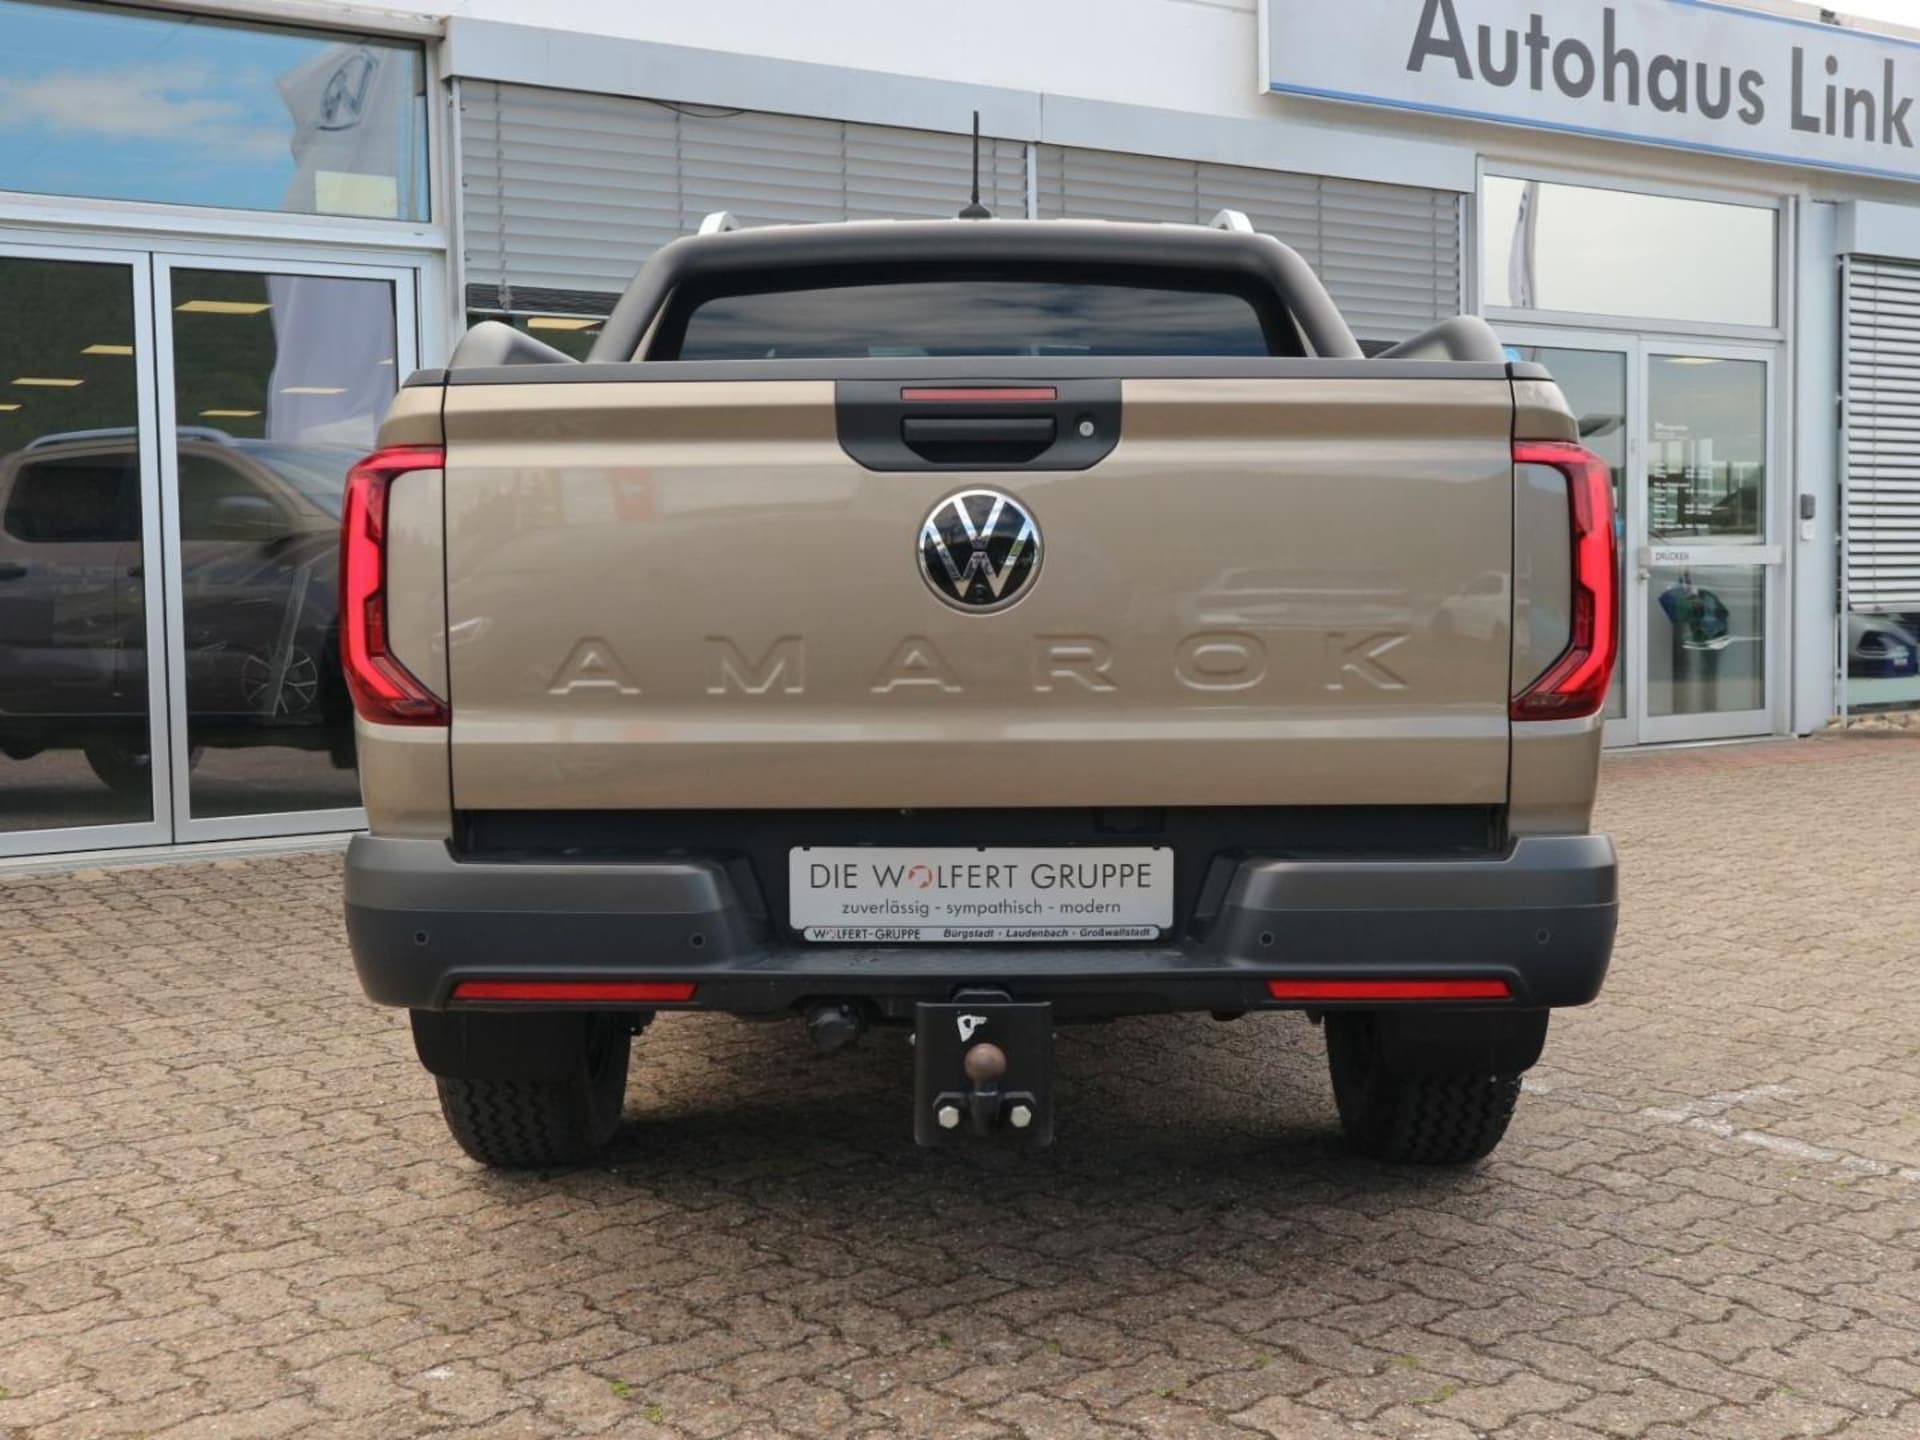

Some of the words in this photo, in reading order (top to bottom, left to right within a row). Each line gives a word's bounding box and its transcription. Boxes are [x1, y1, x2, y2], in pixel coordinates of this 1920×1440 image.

[1406, 0, 1766, 125] Autohaus
[1790, 46, 1916, 148] Link
[548, 631, 1411, 695] AMAROK
[810, 864, 857, 889] DIE
[872, 864, 1018, 889] WOLFERT
[1030, 863, 1152, 889] GRUPPE
[841, 899, 930, 917] zuverlässig
[946, 899, 1043, 917] sympathisch
[1059, 899, 1121, 914] modern
